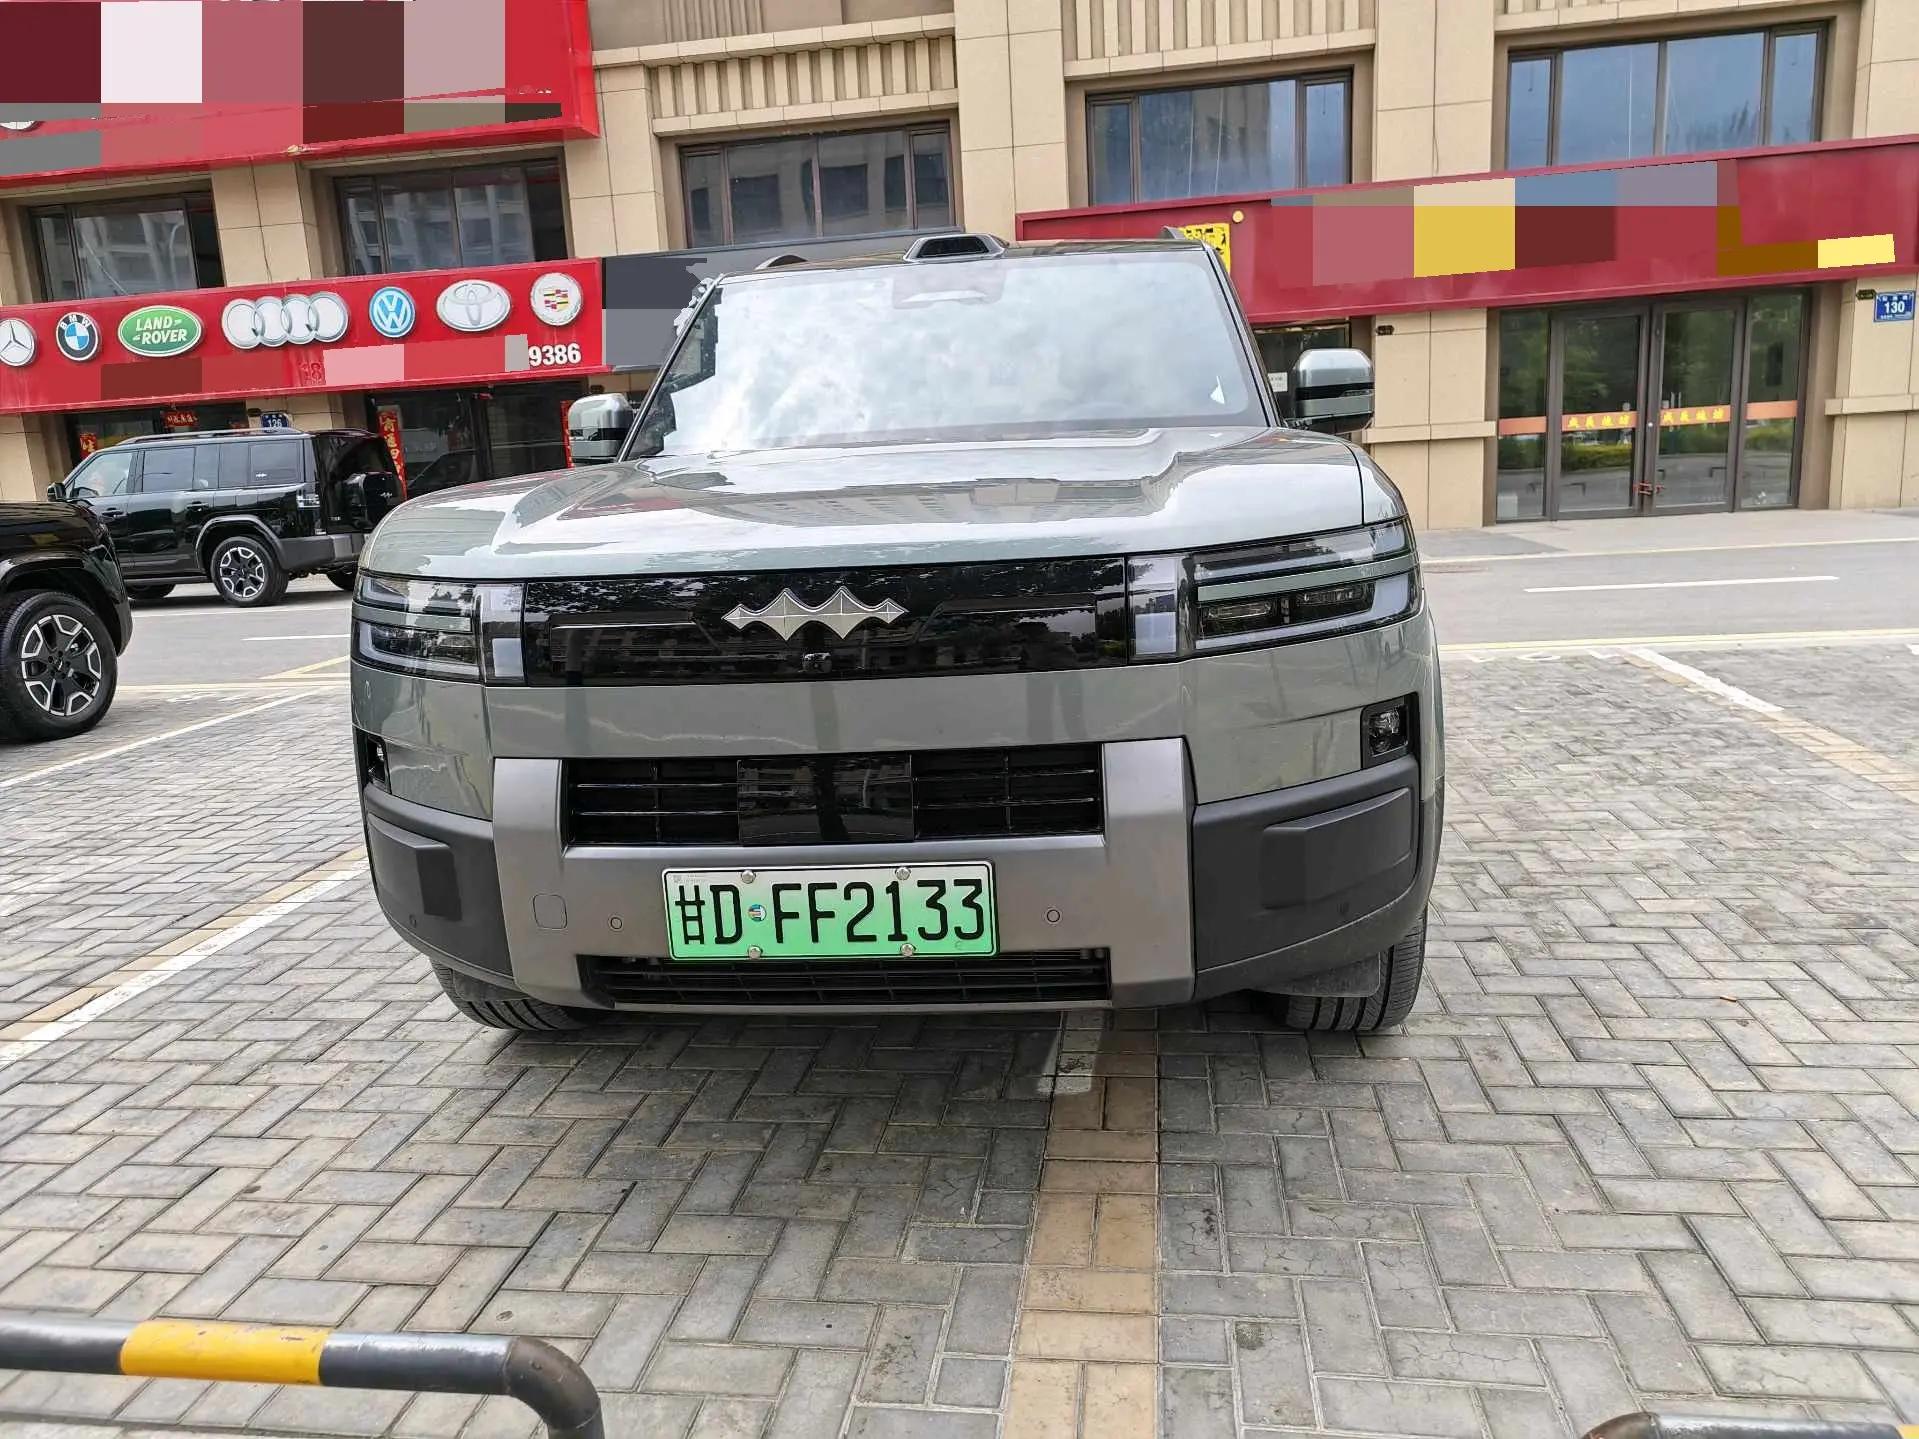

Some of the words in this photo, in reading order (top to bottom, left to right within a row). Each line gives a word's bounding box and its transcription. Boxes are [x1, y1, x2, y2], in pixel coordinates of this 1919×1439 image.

[1884, 300, 1906, 315] 130
[135, 315, 174, 332] LAND
[141, 328, 188, 345] ROVER
[528, 342, 582, 367] 9386
